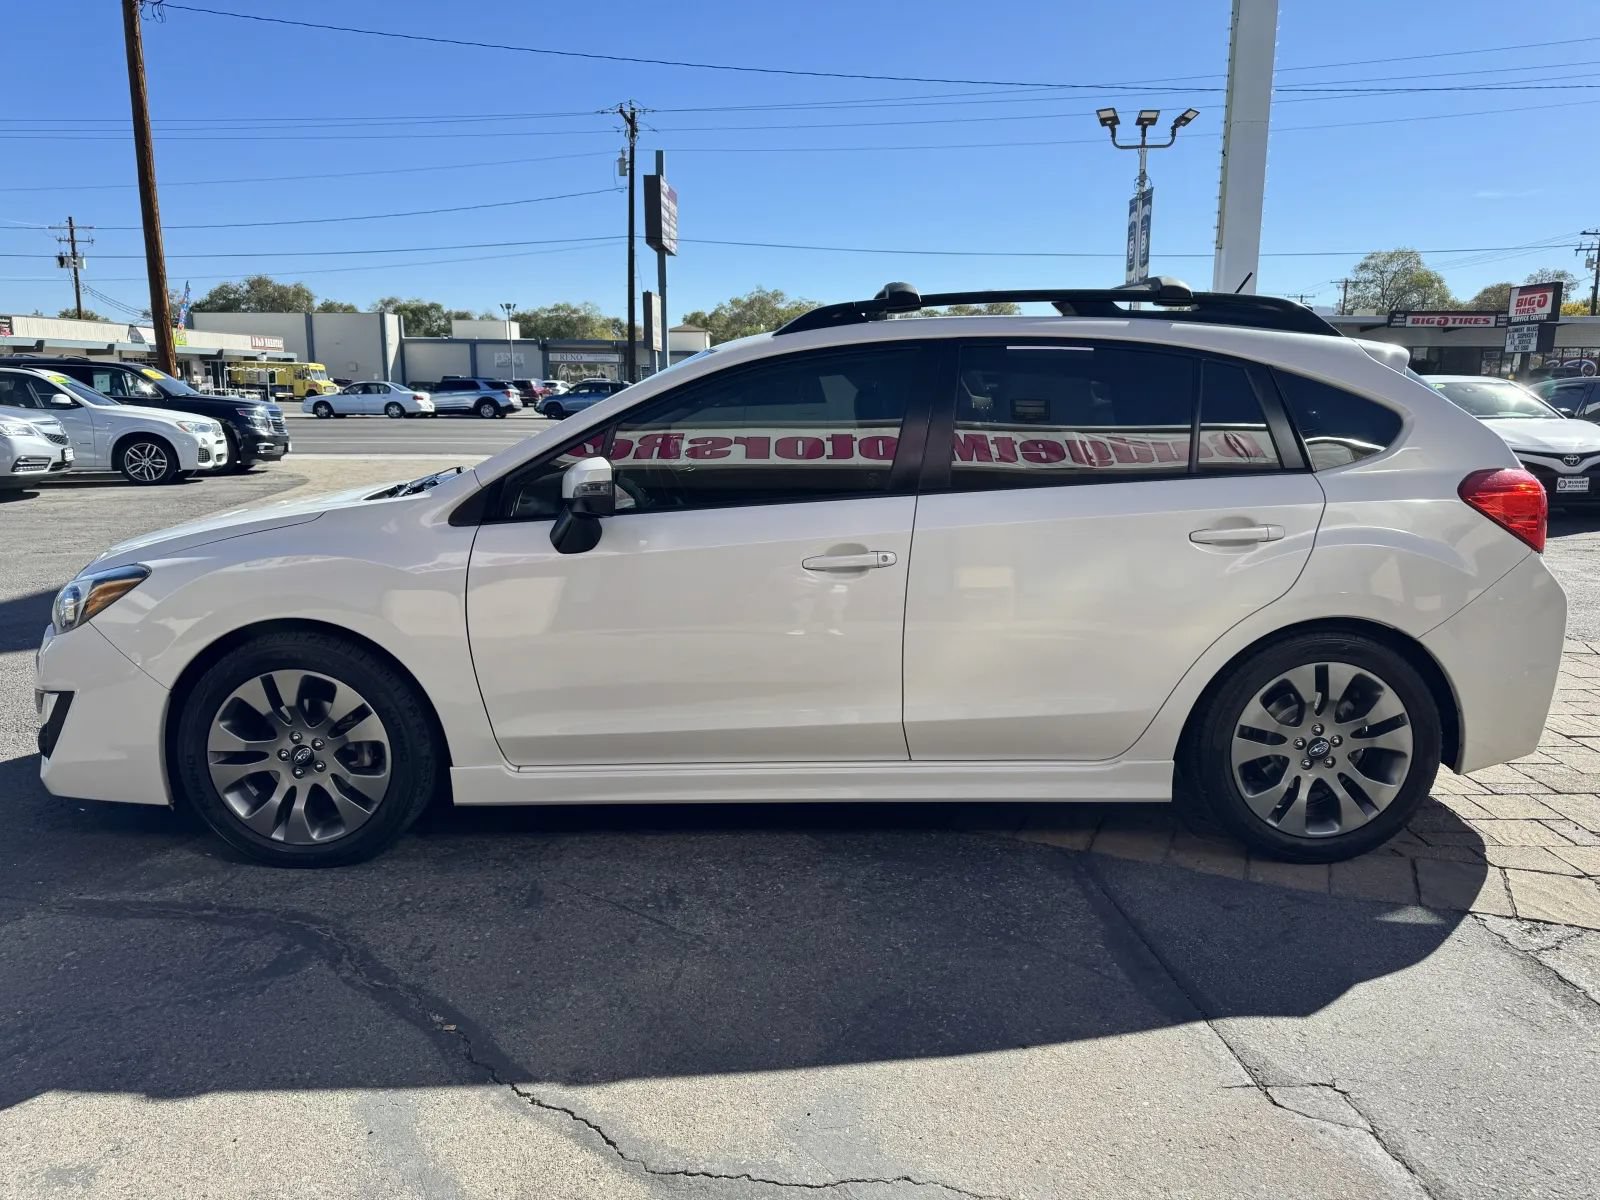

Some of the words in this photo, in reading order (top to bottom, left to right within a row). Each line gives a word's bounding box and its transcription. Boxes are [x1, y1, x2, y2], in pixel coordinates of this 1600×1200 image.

[1516, 296, 1536, 307] BIG
[1514, 307, 1536, 315] TIRES
[1411, 317, 1435, 325] BIG
[1450, 317, 1491, 325] TIRES
[559, 352, 584, 361] RENO
